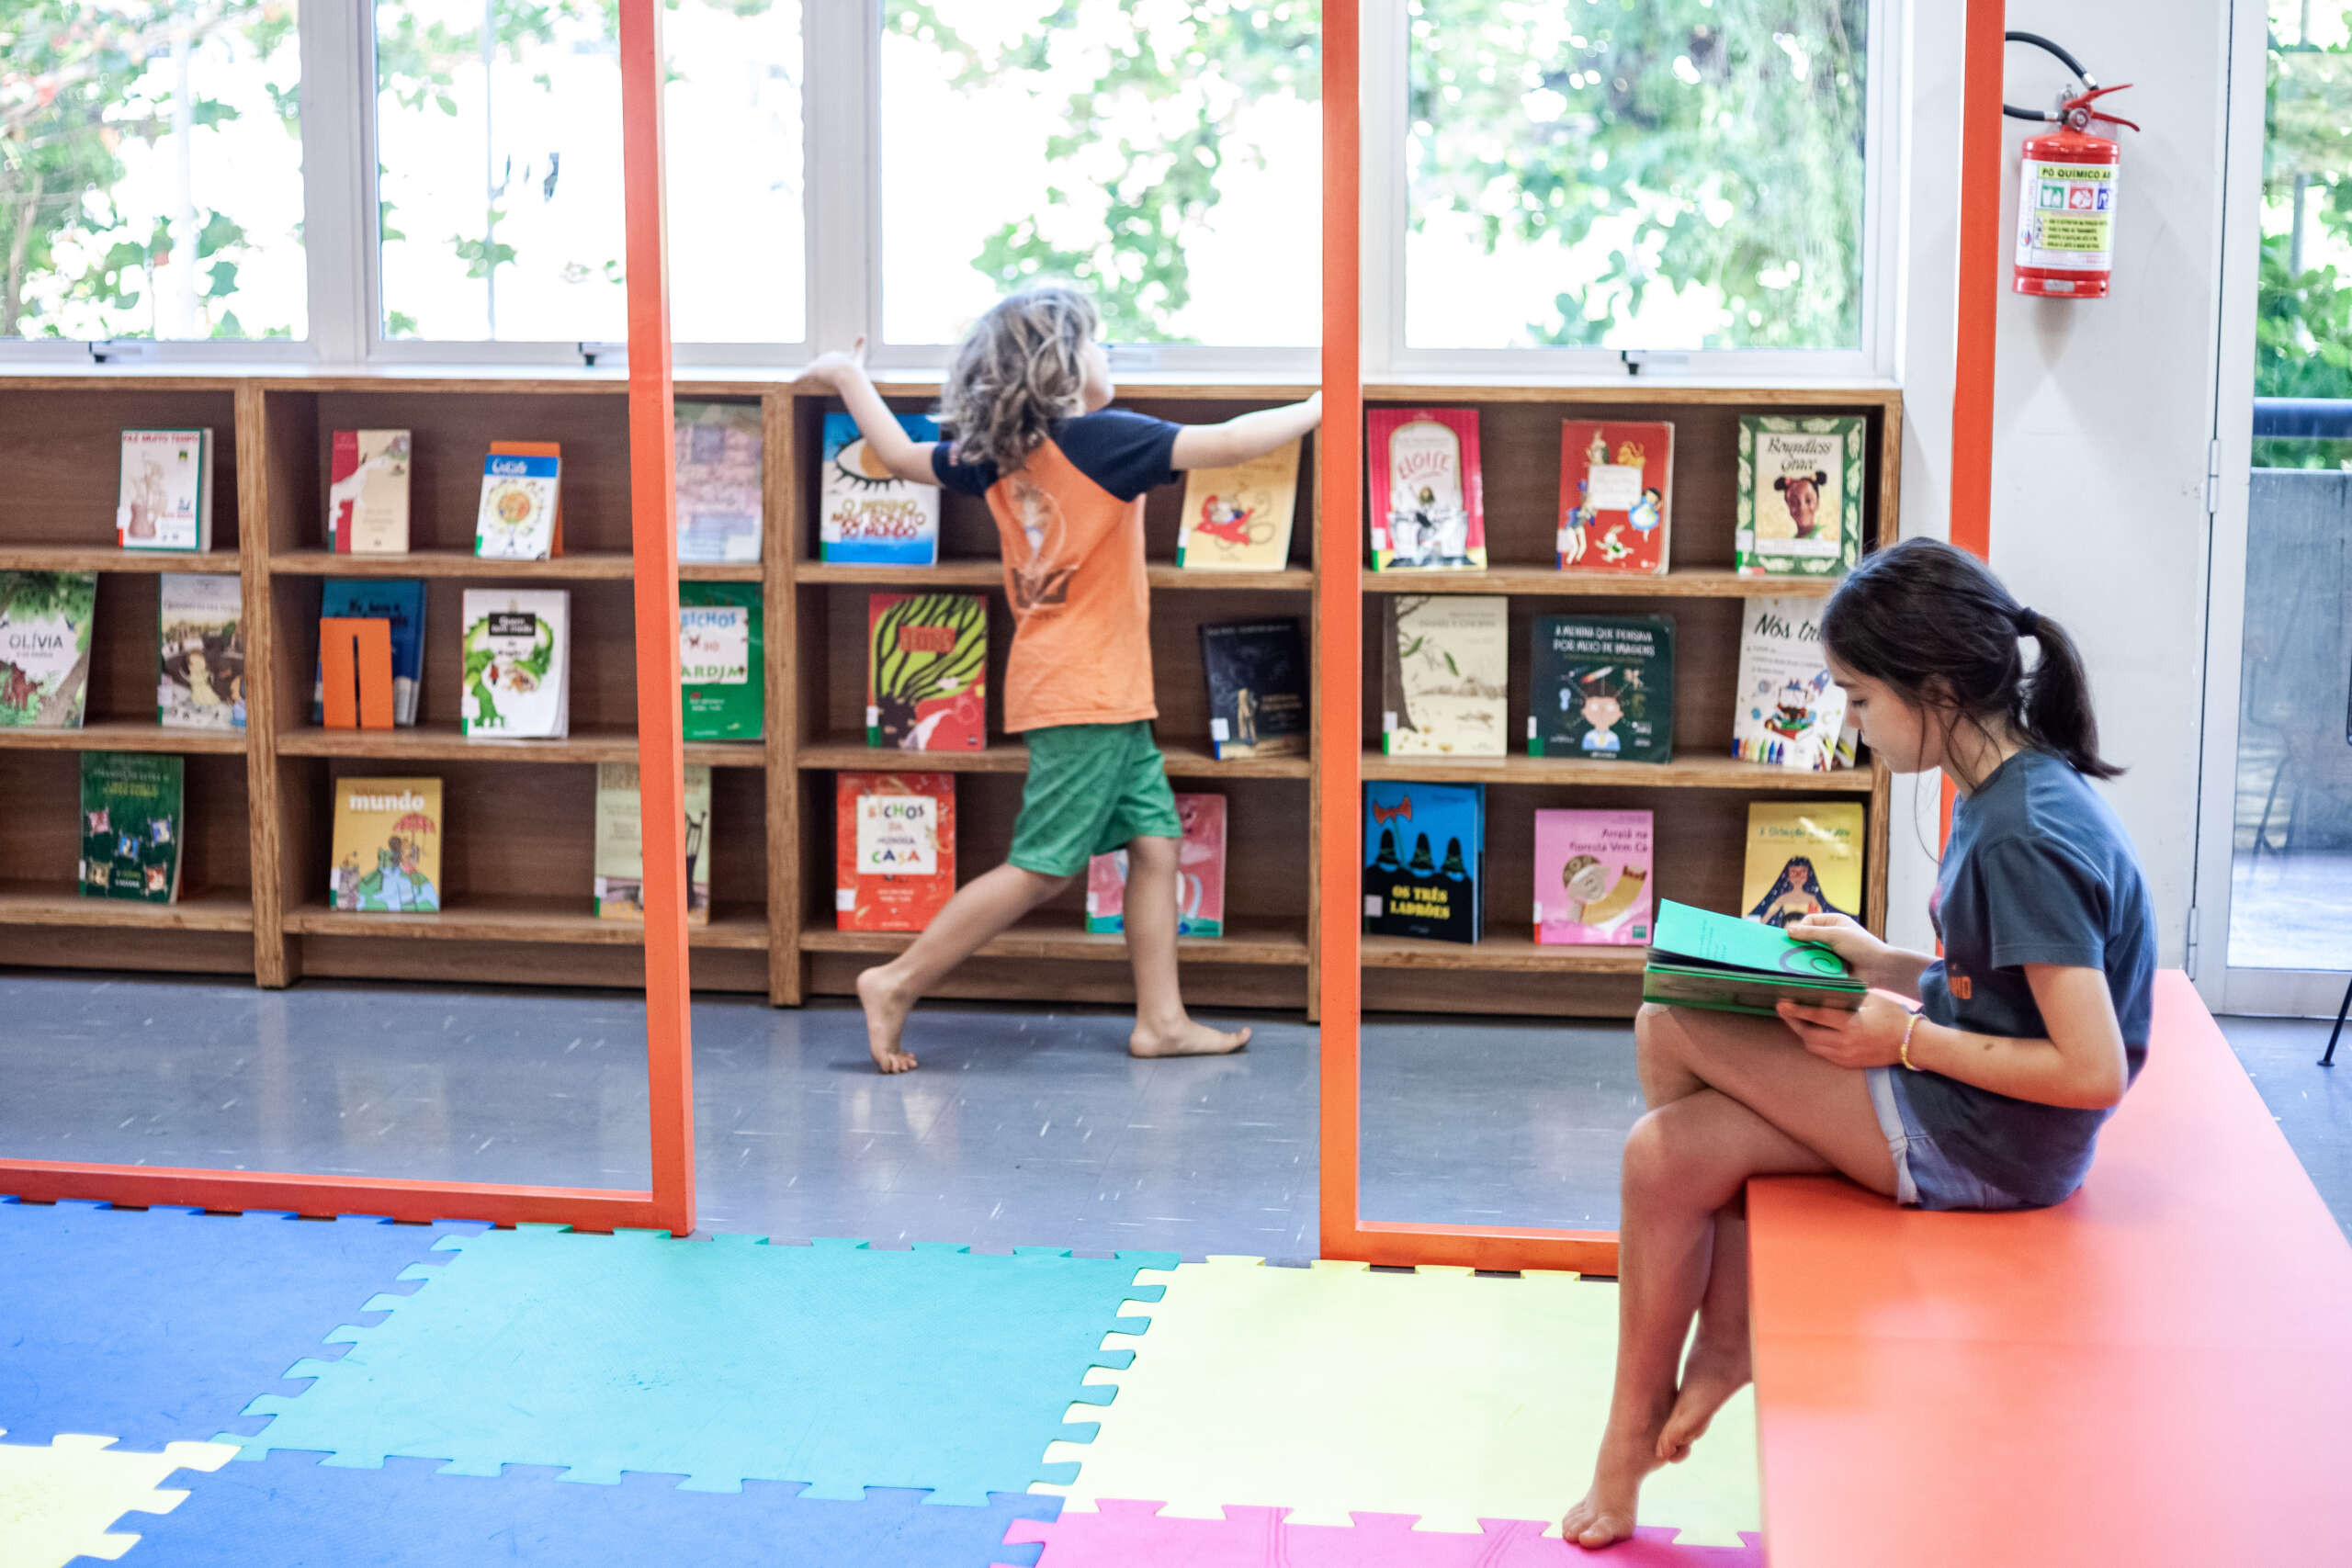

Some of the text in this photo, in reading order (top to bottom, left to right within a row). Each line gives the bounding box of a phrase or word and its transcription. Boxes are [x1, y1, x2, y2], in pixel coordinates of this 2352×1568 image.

[1754, 612, 1791, 639] Nós
[8, 631, 63, 649] OLÍVIA
[681, 665, 744, 678] ARDIM
[349, 790, 424, 811] mundo
[868, 801, 925, 819] BICHOS
[871, 849, 922, 864] CASA
